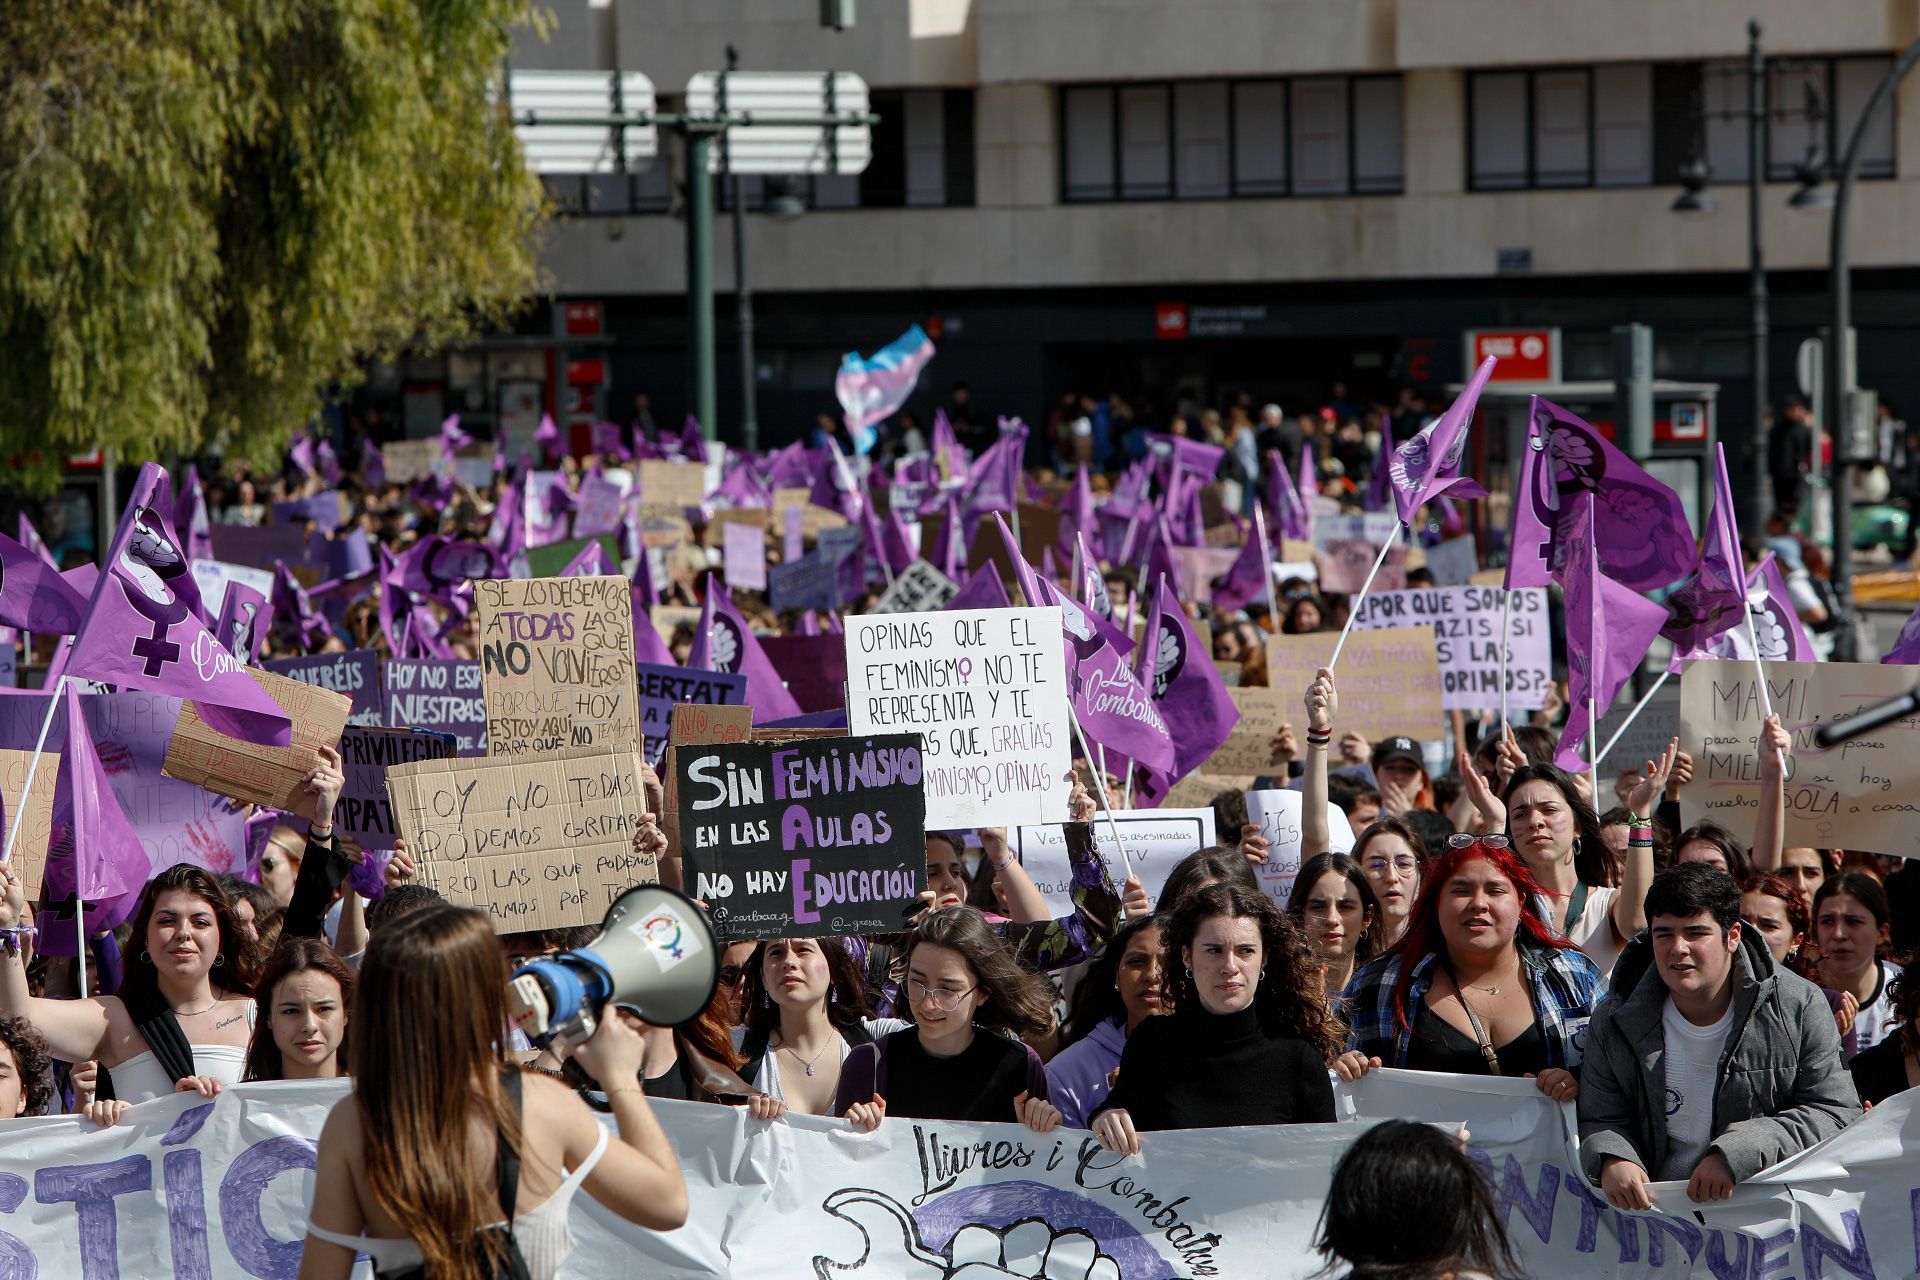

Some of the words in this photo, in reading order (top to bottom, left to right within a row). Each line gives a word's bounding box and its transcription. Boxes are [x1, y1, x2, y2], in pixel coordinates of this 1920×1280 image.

[482, 580, 514, 607] SE
[549, 578, 631, 618] DEBEMOS
[1464, 589, 1540, 613] SOMOS
[487, 613, 503, 635] A
[500, 611, 575, 643] TODAS
[583, 611, 625, 636] LAS
[583, 631, 628, 651] QUE
[860, 621, 933, 653] OPINAS
[955, 618, 987, 649] QUE
[1011, 618, 1036, 647] EL
[1511, 617, 1532, 637] SI
[484, 640, 531, 677] NO
[985, 654, 1013, 685] NO
[1020, 653, 1046, 683] TE
[388, 661, 417, 690] HOY
[420, 664, 447, 689] NO
[391, 693, 486, 728] NUESTRAS
[576, 693, 620, 719] HOY
[676, 705, 708, 738] NO
[869, 691, 975, 725] REPRESENTA
[988, 690, 999, 718] Y
[1010, 689, 1032, 718] TE
[489, 718, 540, 740] ESTOY
[541, 713, 573, 738] AQUÍ
[571, 726, 593, 747] NO
[992, 722, 1052, 752] GRACIAS
[494, 739, 530, 757] PARA
[1703, 734, 1741, 759] para
[1841, 740, 1885, 760] pases
[688, 755, 764, 810] SIN
[771, 740, 922, 801] FEMINISMO
[996, 760, 1051, 793] OPINAS
[1860, 766, 1892, 791] hoy
[408, 779, 478, 832] HOY
[506, 781, 549, 818] NO
[569, 773, 632, 808] TODAS
[1705, 793, 1759, 808] vuelvo
[1849, 804, 1861, 813] a
[1872, 803, 1920, 813] casa
[695, 825, 719, 848] EN
[730, 819, 770, 845] LAS
[781, 804, 892, 851] AULAS
[1130, 832, 1192, 842] asesinadas
[416, 826, 546, 872] PODEMOS
[492, 868, 531, 888] LAS
[544, 863, 583, 881] QUE
[596, 855, 655, 874] PODEMOS
[560, 888, 590, 910] POR
[697, 872, 734, 900] NO
[746, 871, 788, 895] HAY
[791, 858, 916, 925] EDUCACIÓN
[1046, 1139, 1065, 1172] i
